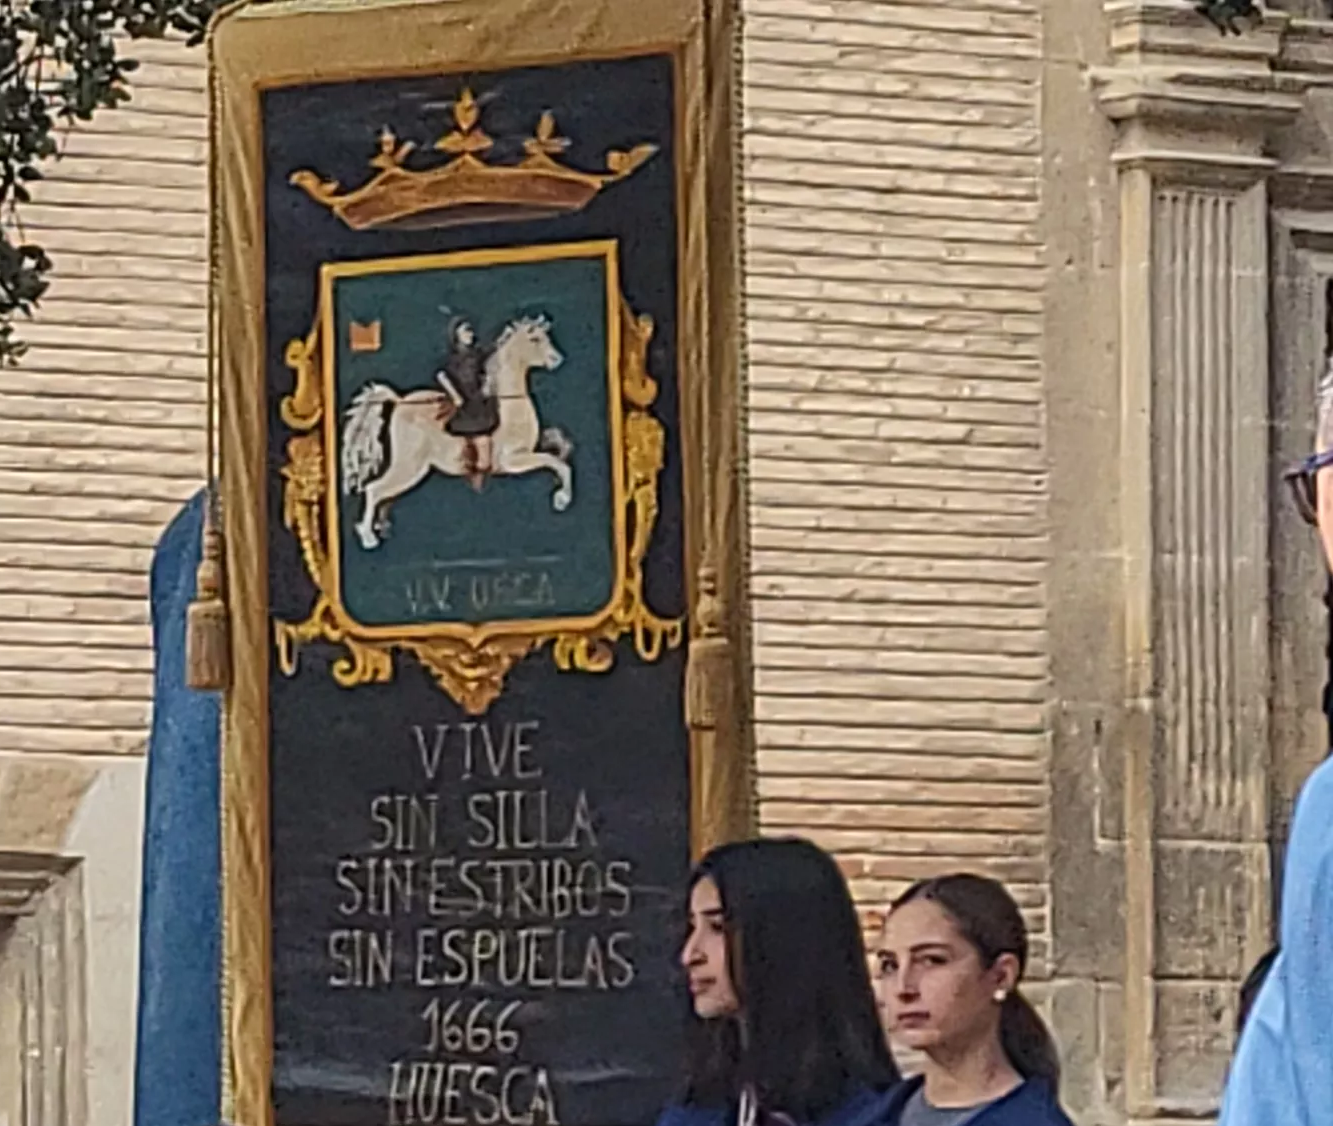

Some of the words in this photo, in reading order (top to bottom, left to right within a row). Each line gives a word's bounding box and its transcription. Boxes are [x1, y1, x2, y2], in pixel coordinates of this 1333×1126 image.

[412, 720, 543, 780] VIVE
[370, 794, 439, 850] SIN
[467, 789, 598, 849] SILLA
[336, 857, 414, 916] SIN
[429, 856, 631, 918] ESTRIBOS
[329, 928, 393, 988] SIN
[416, 928, 633, 989] ESPUELAS
[421, 998, 523, 1053] 1666
[388, 1060, 560, 1126] HUESCA
